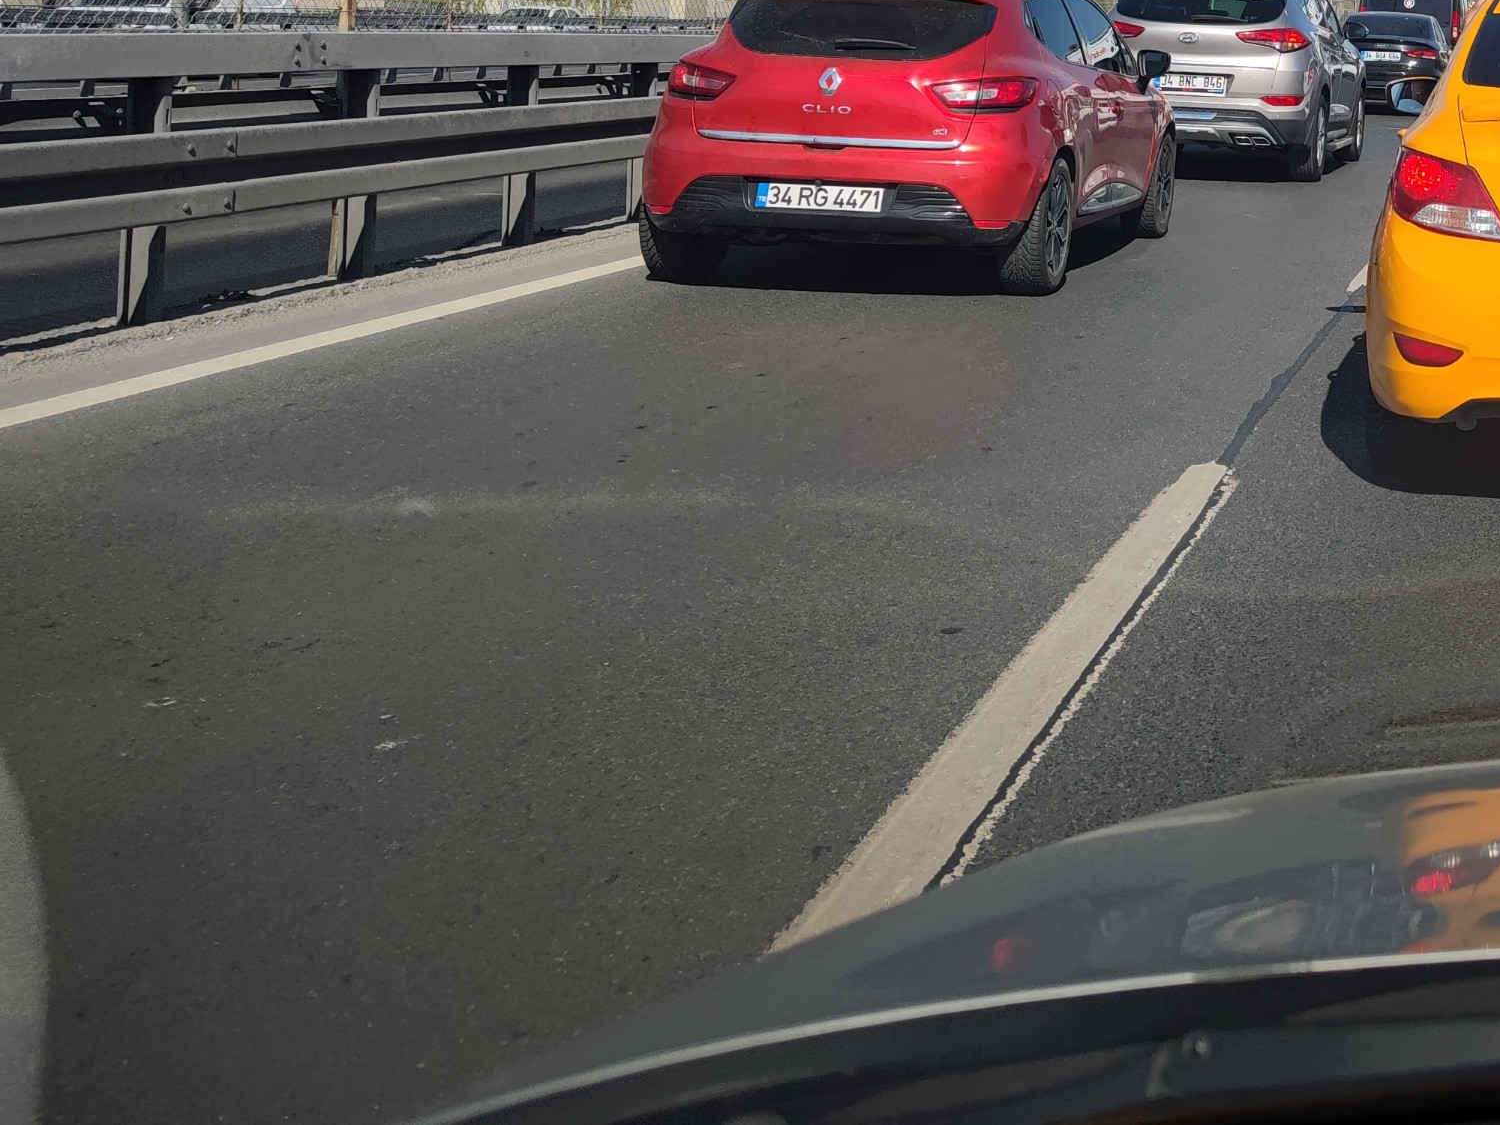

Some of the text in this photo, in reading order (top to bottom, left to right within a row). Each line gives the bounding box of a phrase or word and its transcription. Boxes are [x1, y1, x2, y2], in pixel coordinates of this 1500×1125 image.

[1162, 74, 1222, 88] 34 BNC 846
[801, 103, 853, 115] CLIO
[758, 185, 880, 210] TR 34 RG 4471
